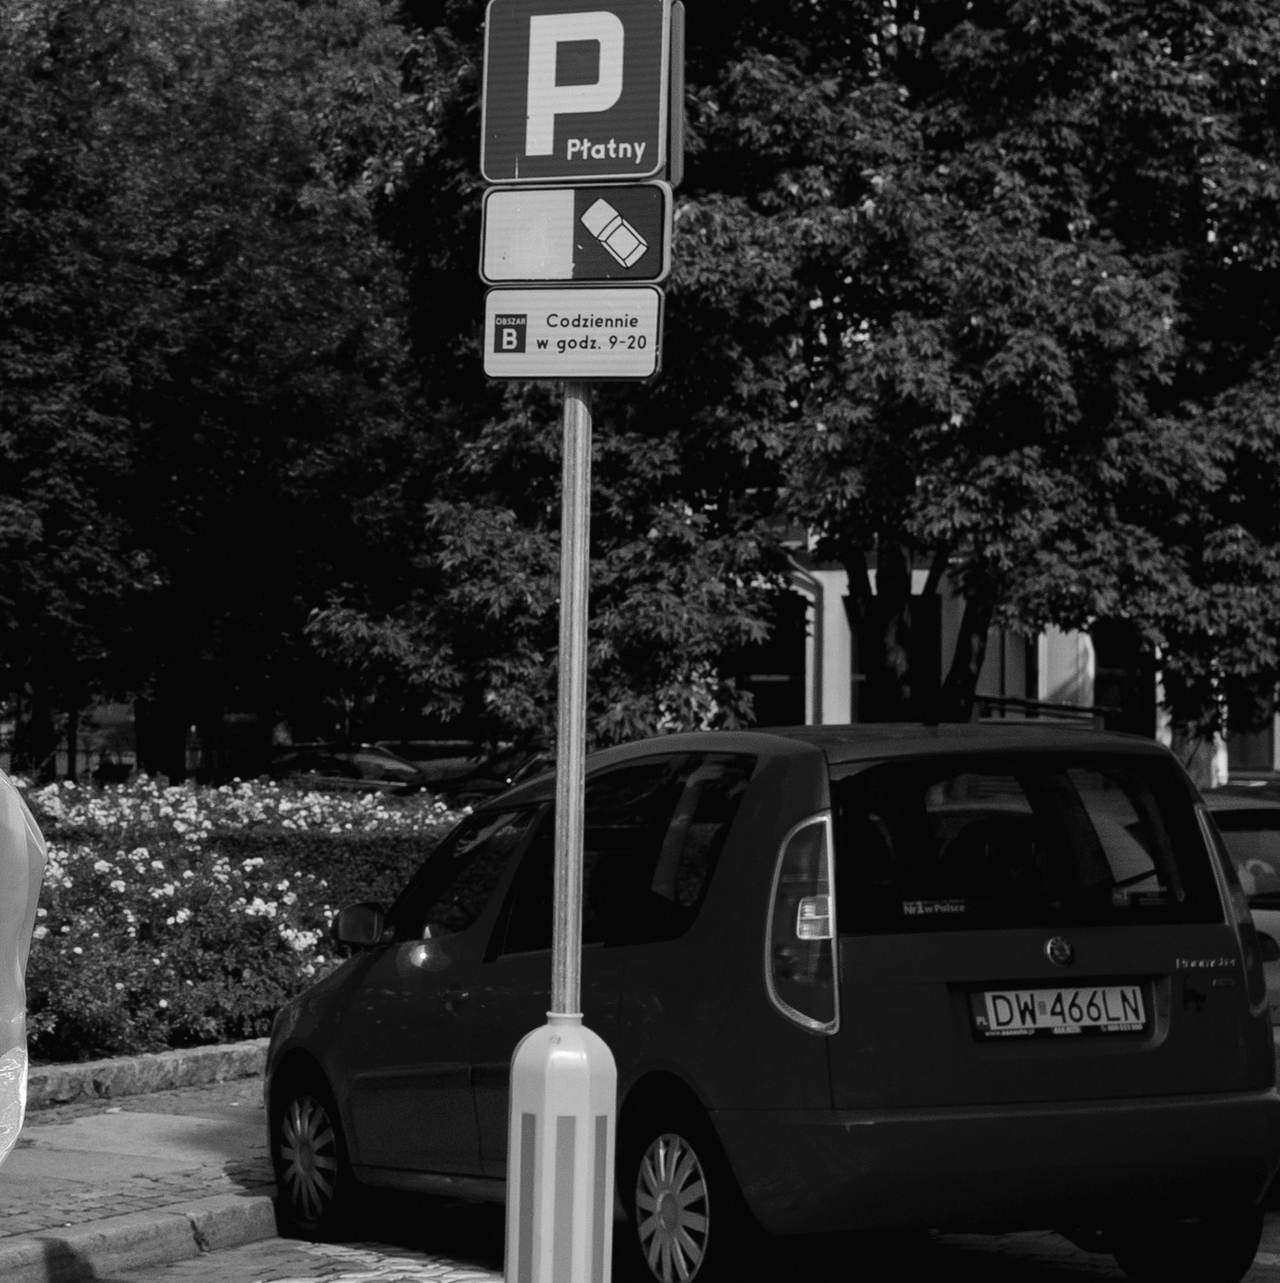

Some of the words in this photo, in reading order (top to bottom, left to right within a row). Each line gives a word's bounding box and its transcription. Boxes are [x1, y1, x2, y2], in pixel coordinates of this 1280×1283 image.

[525, 11, 625, 156] P
[567, 138, 646, 165] Płatny
[495, 317, 526, 326] OBSZAR
[546, 313, 639, 328] Codziennie
[502, 328, 518, 350] B
[536, 338, 549, 350] w
[557, 335, 601, 354] godz.
[609, 335, 647, 350] 9-20
[991, 993, 1037, 1027] DW
[1050, 989, 1141, 1023] 466LN
